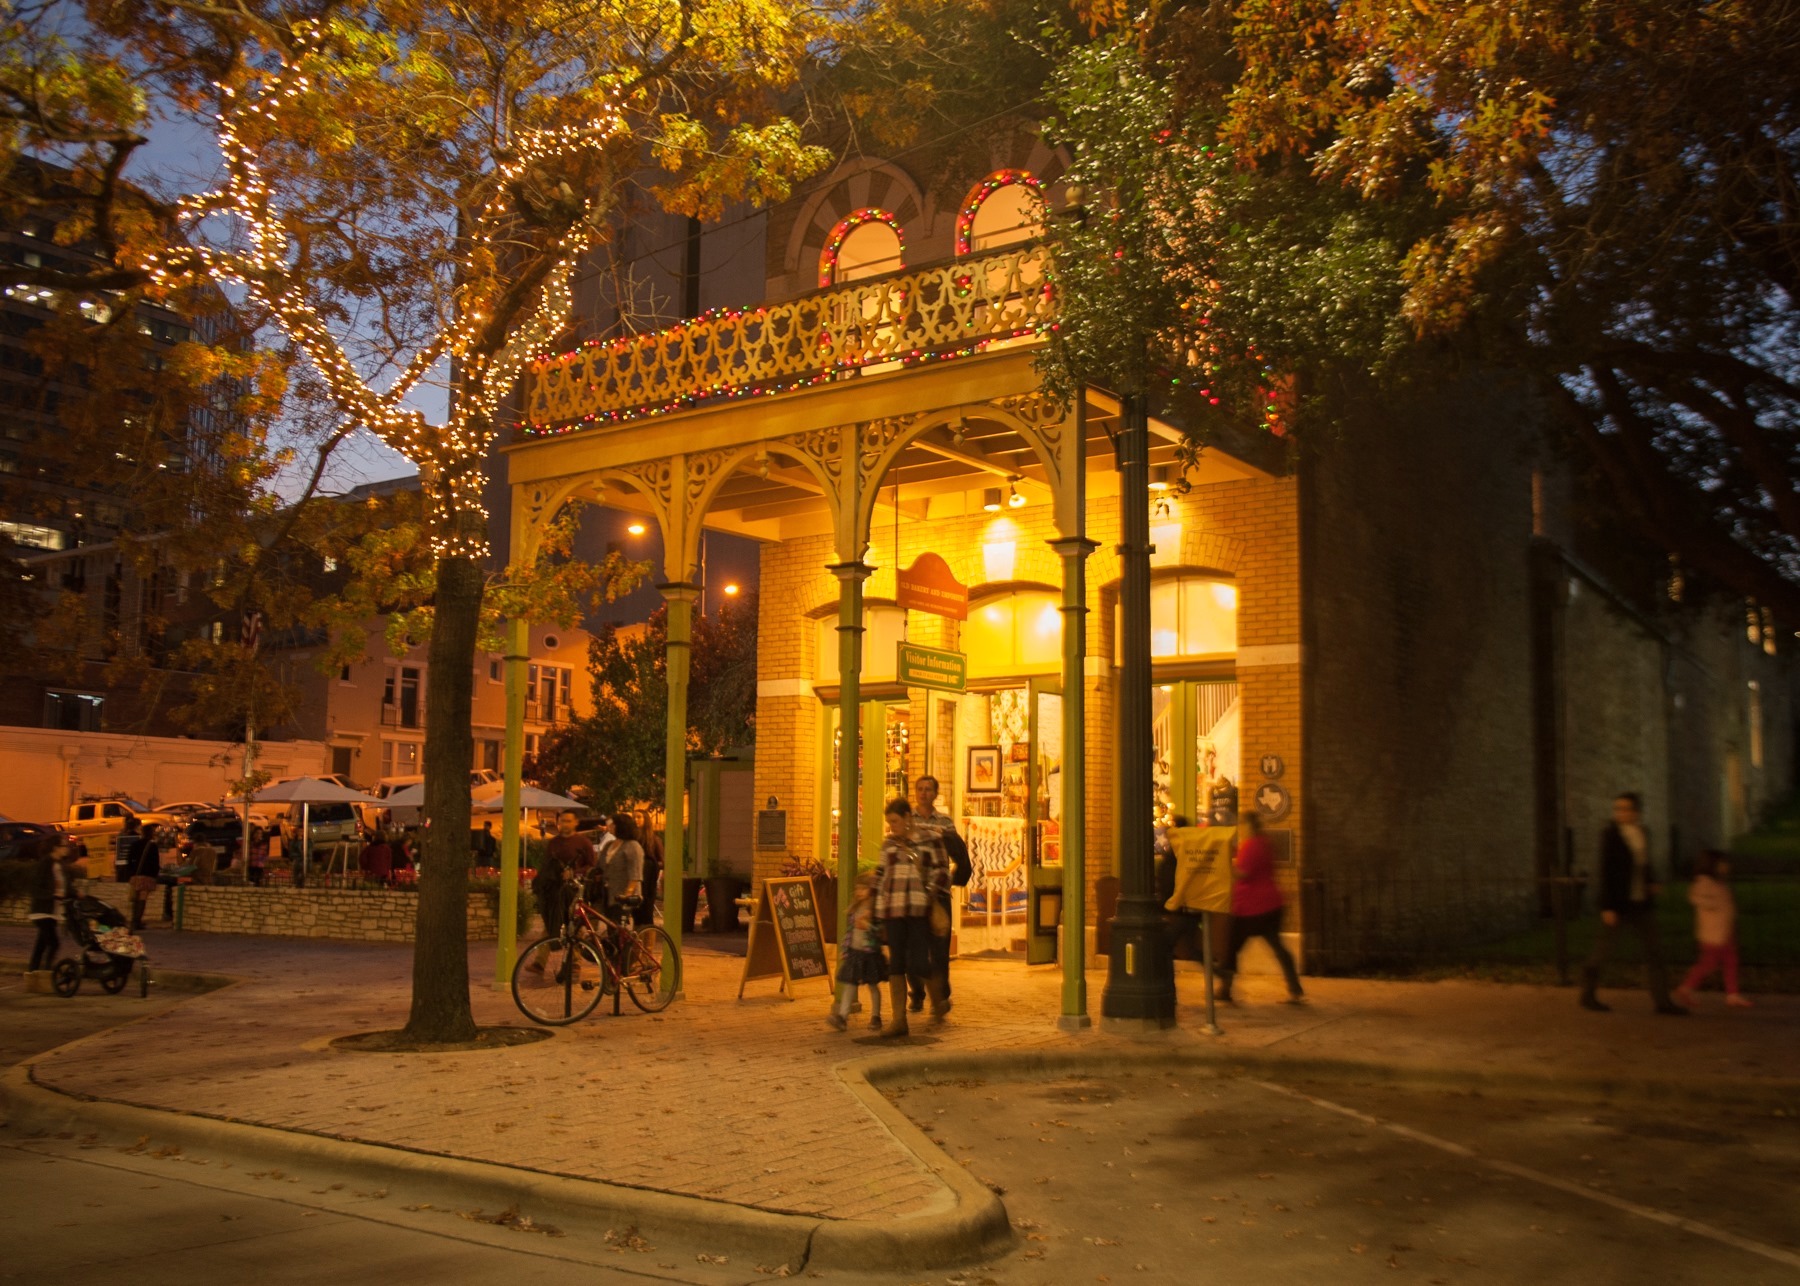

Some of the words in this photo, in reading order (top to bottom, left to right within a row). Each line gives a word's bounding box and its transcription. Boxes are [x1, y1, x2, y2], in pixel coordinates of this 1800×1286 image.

[911, 583, 929, 594] BAKERY
[930, 588, 940, 597] AND
[906, 650, 926, 666] Visitor
[927, 655, 962, 673] Information
[789, 884, 805, 898] Gift
[793, 899, 810, 911] Shop
